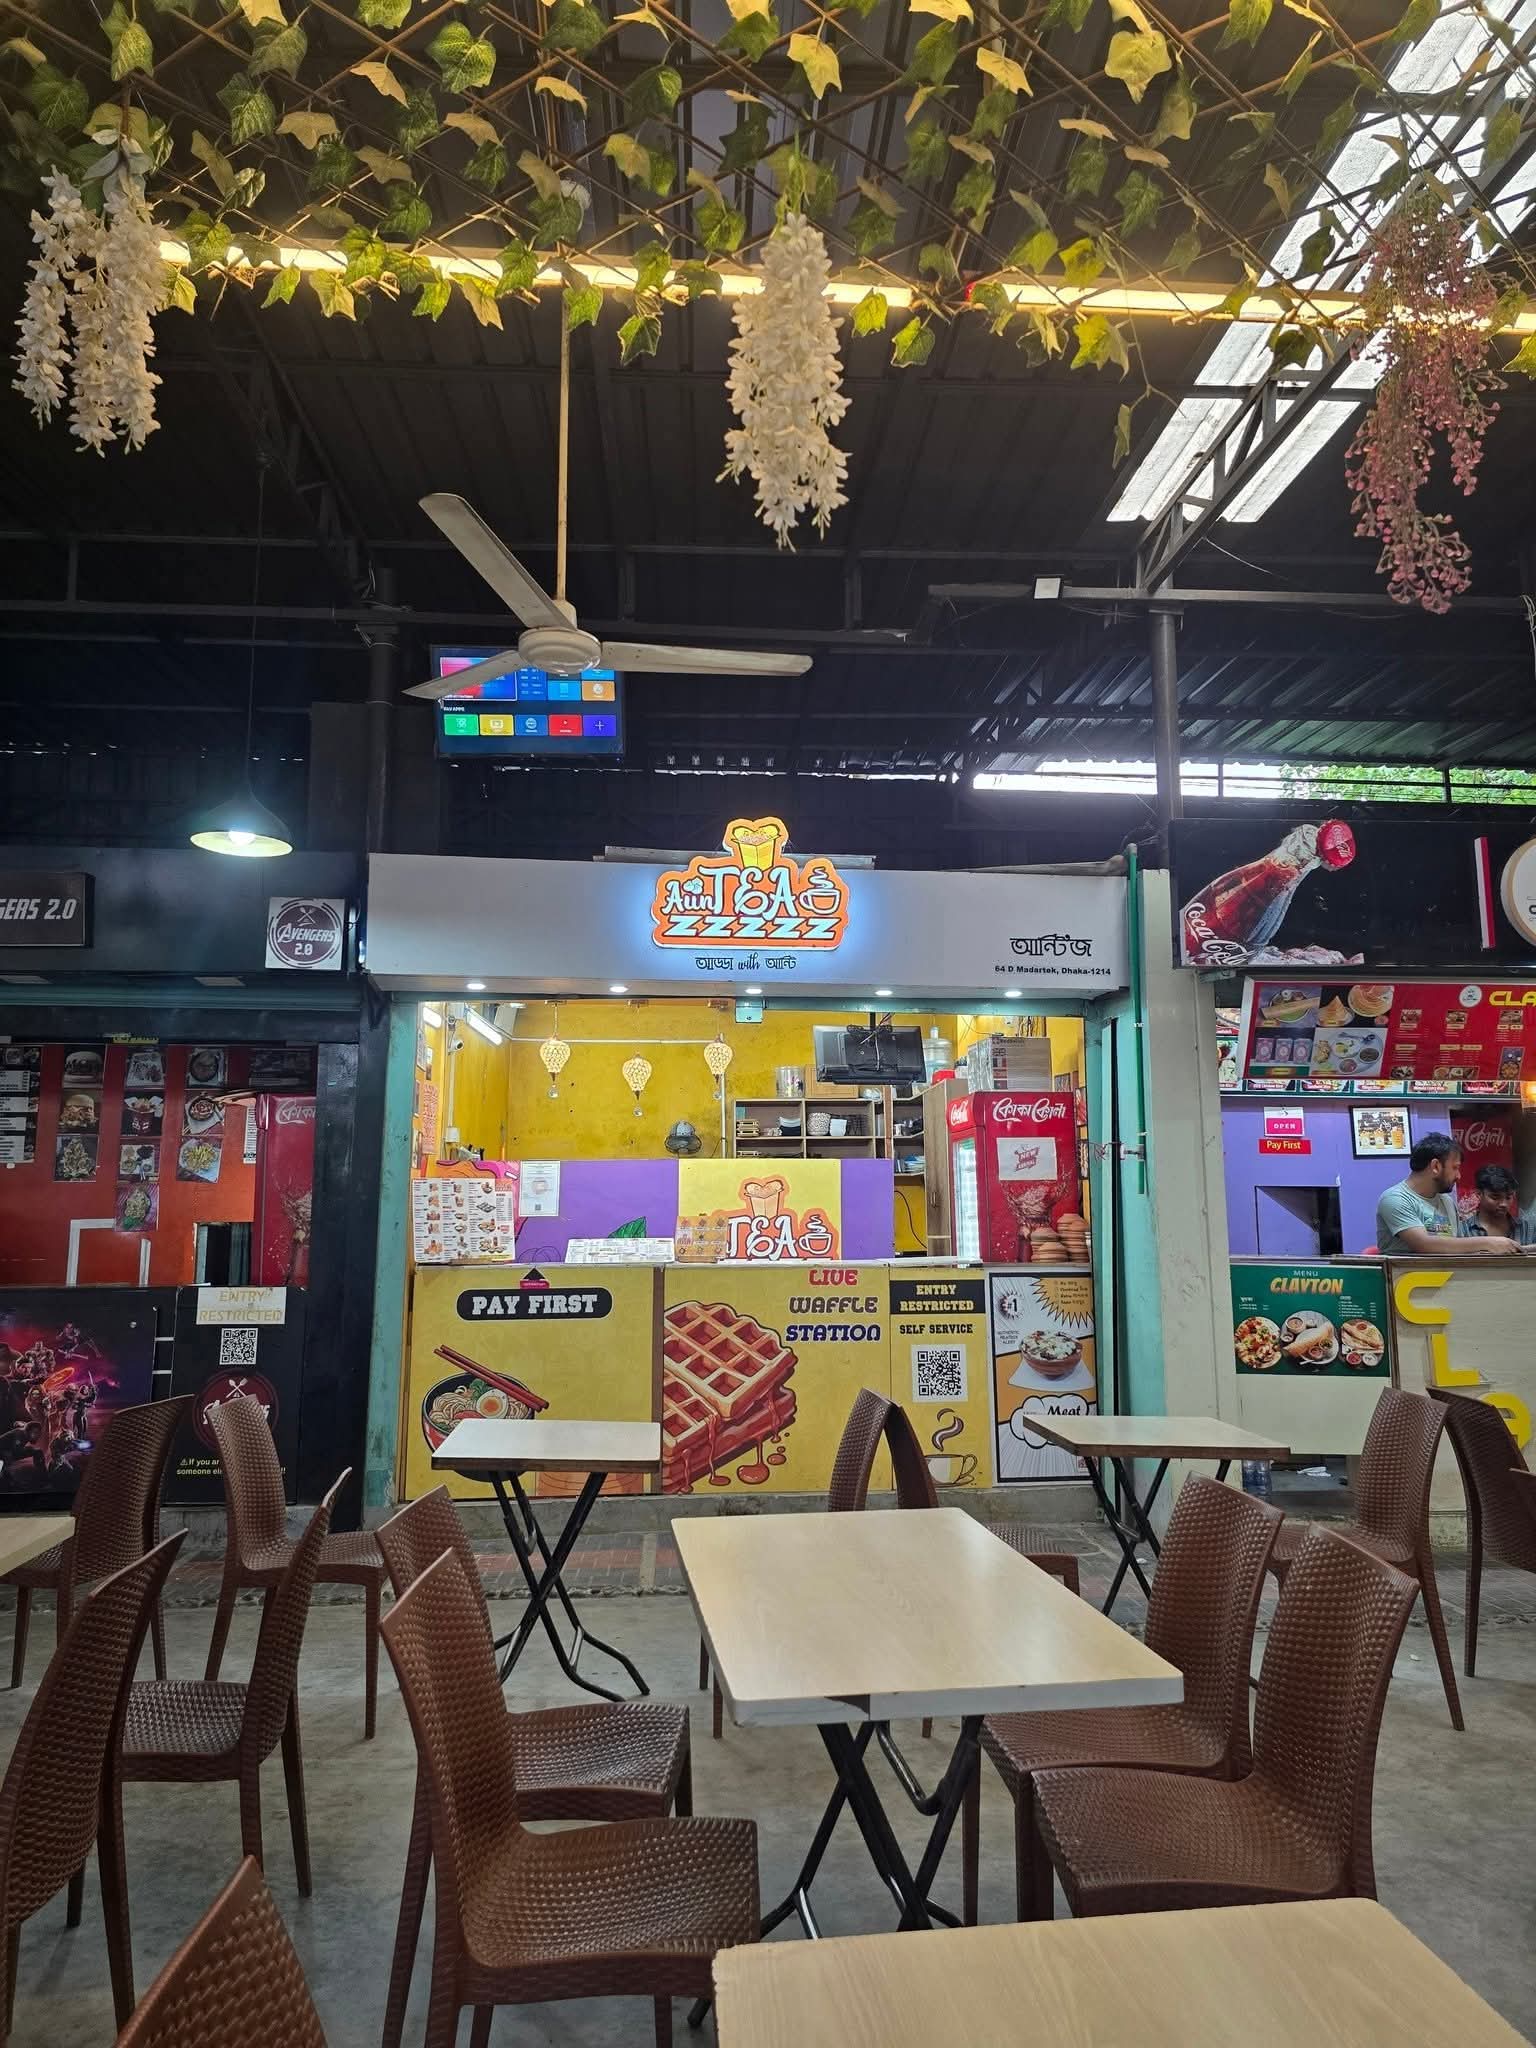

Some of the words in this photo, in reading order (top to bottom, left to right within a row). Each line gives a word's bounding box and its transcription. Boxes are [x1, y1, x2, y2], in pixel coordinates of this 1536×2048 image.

[44, 898, 77, 920] 2.0
[737, 952, 760, 970] with
[1061, 967, 1111, 975] Dhaka-1214
[1266, 1141, 1281, 1150] Pay
[1283, 1141, 1301, 1149] First
[809, 1269, 858, 1285] LIVE
[916, 1284, 956, 1296] ENTRY
[1270, 1277, 1344, 1294] CLAYTON
[218, 1290, 265, 1302] ENTRY
[472, 1296, 520, 1315] PAY
[528, 1294, 598, 1314] FIRST
[789, 1296, 878, 1313] WAFFLE
[900, 1300, 974, 1312] RESTRICTED
[200, 1309, 283, 1322] RESTRICTED
[785, 1324, 881, 1341] STATION
[899, 1324, 925, 1334] SELF
[929, 1323, 973, 1334] SERVICE
[196, 1459, 210, 1467] you
